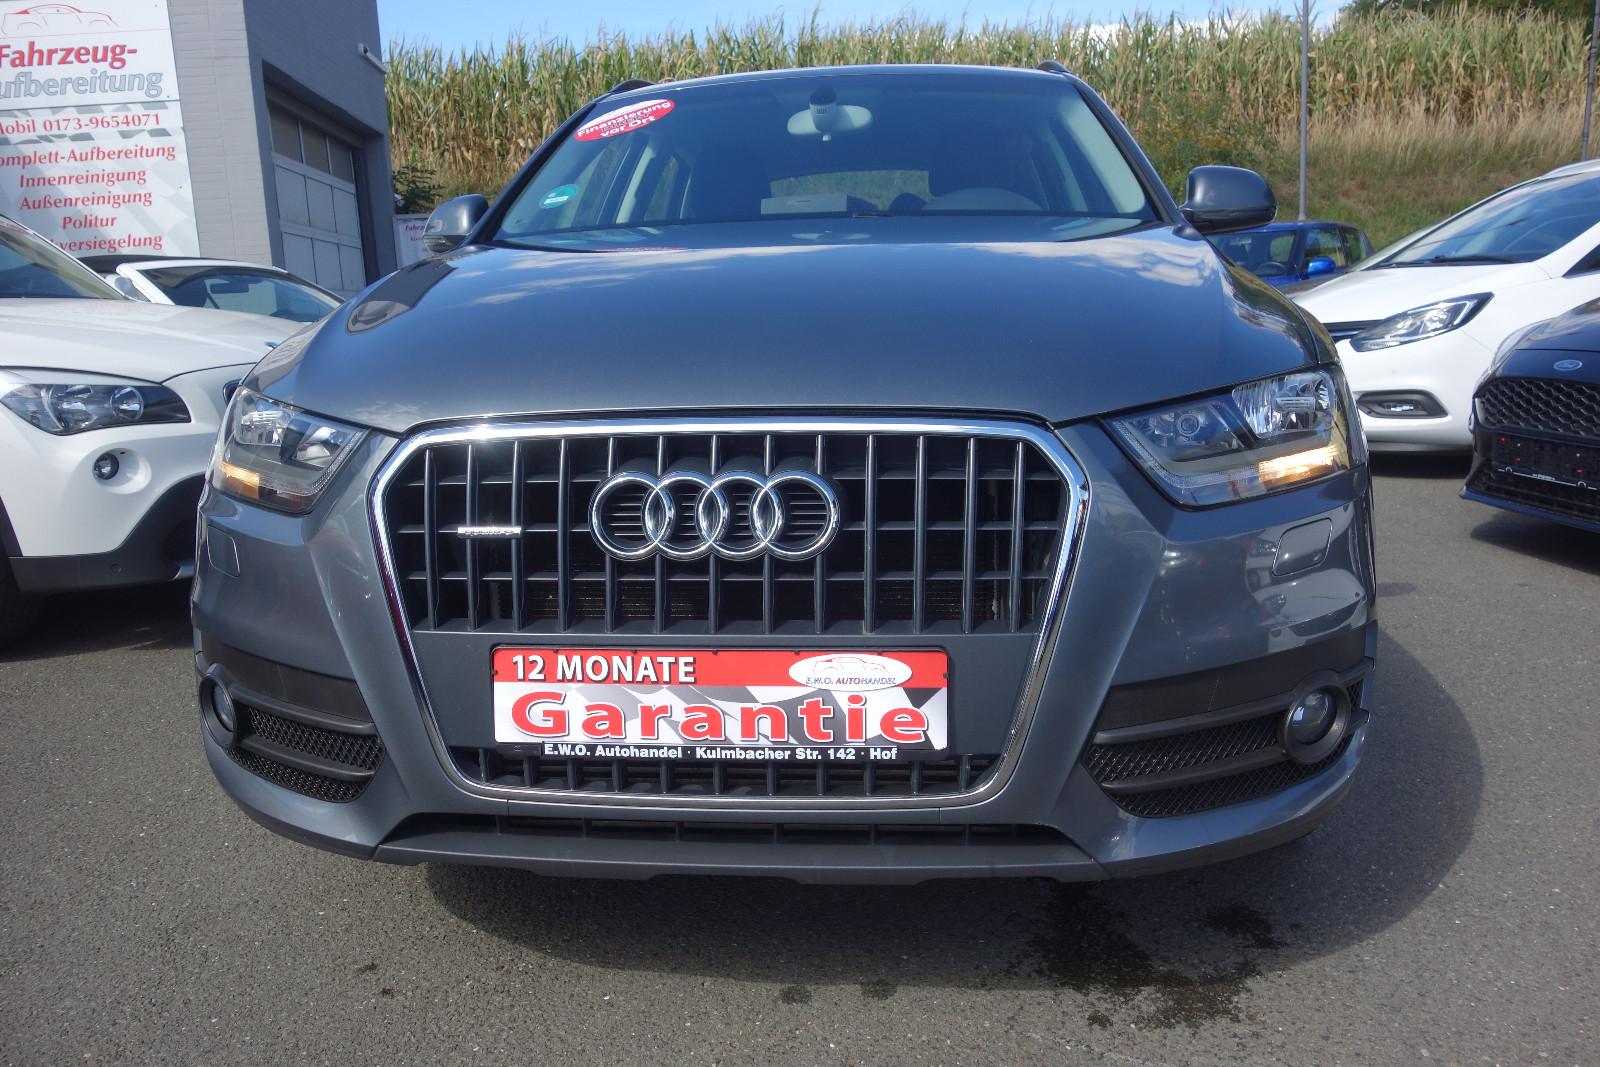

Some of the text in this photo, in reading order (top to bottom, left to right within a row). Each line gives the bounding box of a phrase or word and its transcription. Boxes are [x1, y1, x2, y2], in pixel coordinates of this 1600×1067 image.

[0, 41, 138, 70] Fahrzeug-
[43, 113, 161, 132] 0173-9654071
[629, 116, 656, 127] Ort
[19, 169, 147, 188] Innenreinigung
[19, 191, 153, 211] Außenreinigung
[61, 214, 118, 230] Politur
[51, 233, 163, 253] versiegelung
[512, 655, 696, 683] 12 MONATE
[805, 677, 897, 685] E.W.O. AUTOHANDEL
[511, 690, 928, 743] Garantie
[544, 744, 898, 760] E.W.O. Autohandel Kulmbacher Str. 142 Hof
